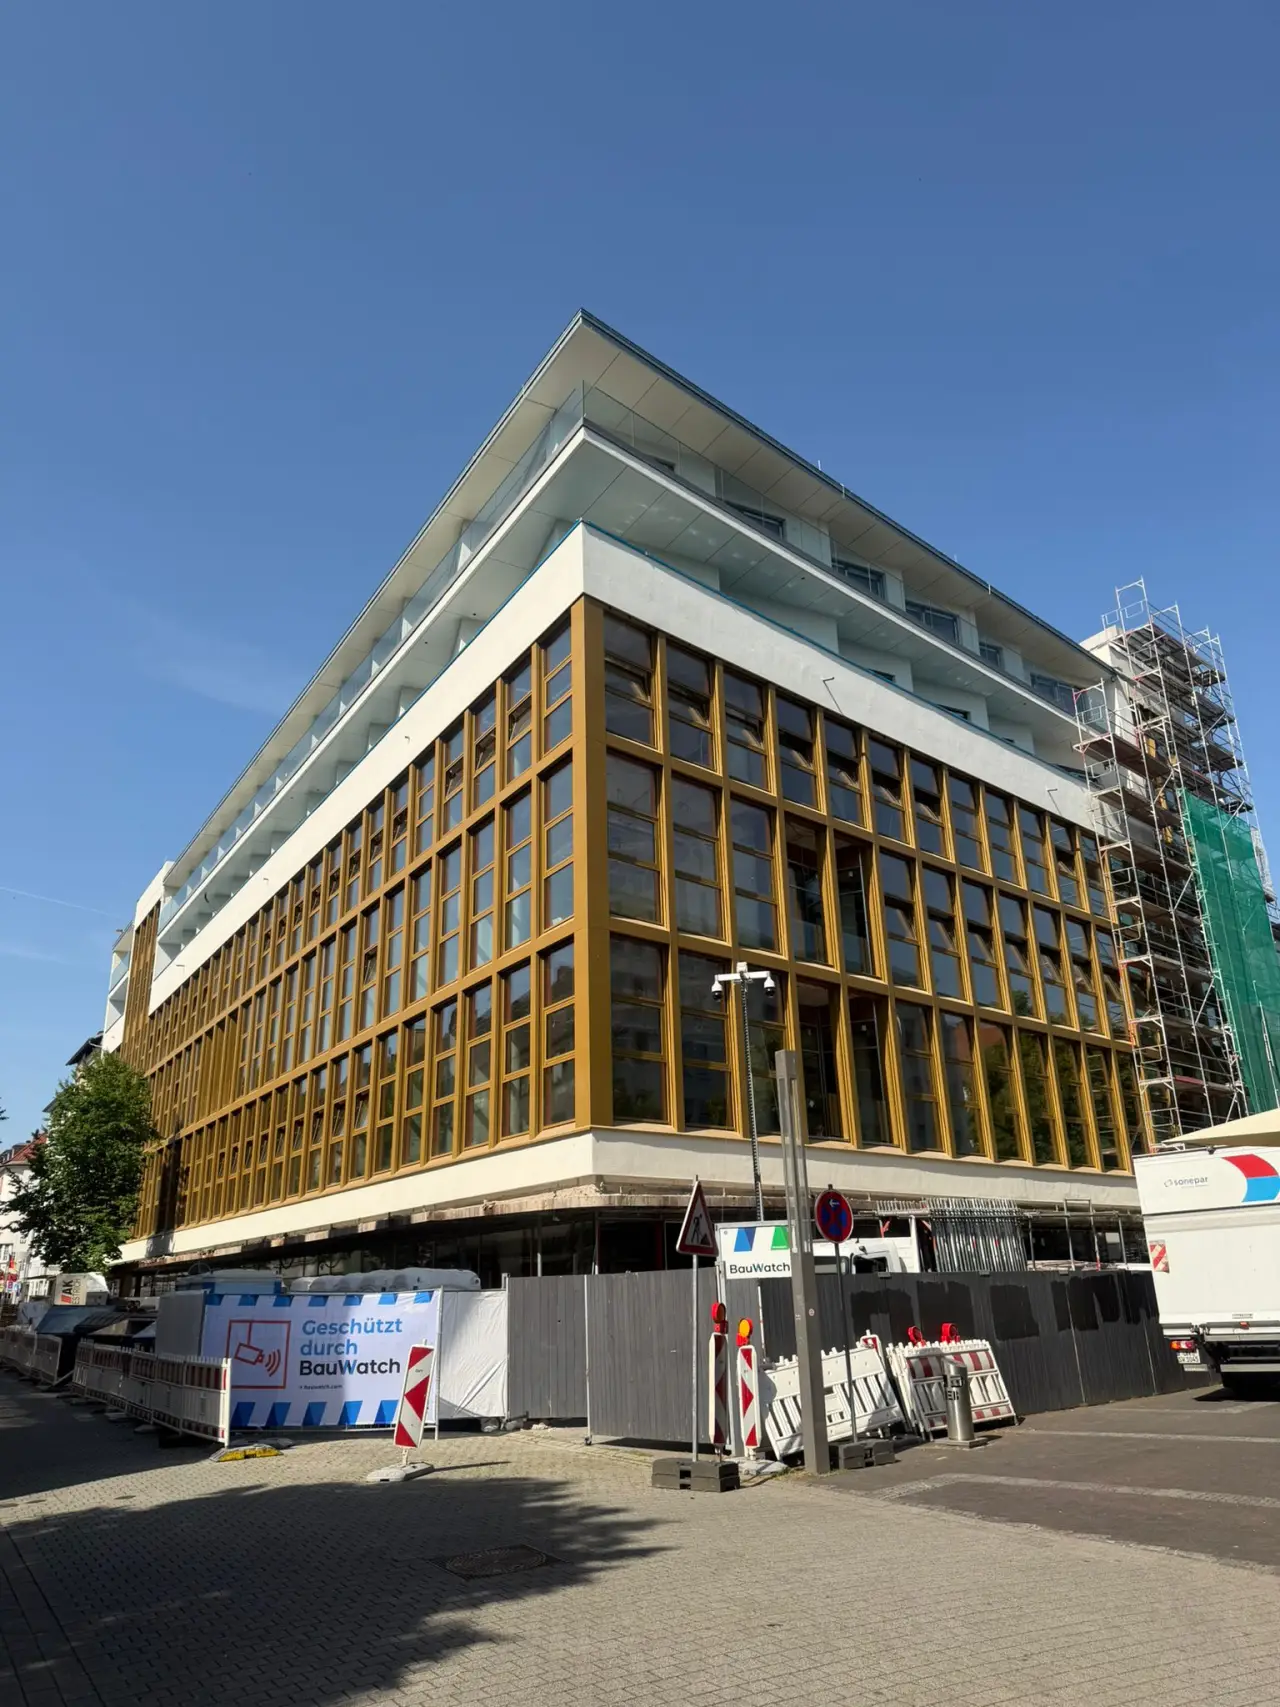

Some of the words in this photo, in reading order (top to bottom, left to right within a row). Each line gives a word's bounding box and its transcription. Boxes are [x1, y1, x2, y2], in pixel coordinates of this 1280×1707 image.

[1173, 1177, 1208, 1186] sonepar
[729, 1262, 791, 1274] BauWatch
[302, 1318, 403, 1335] Geschützt
[300, 1339, 358, 1356] durch
[299, 1358, 401, 1376] BauWatch
